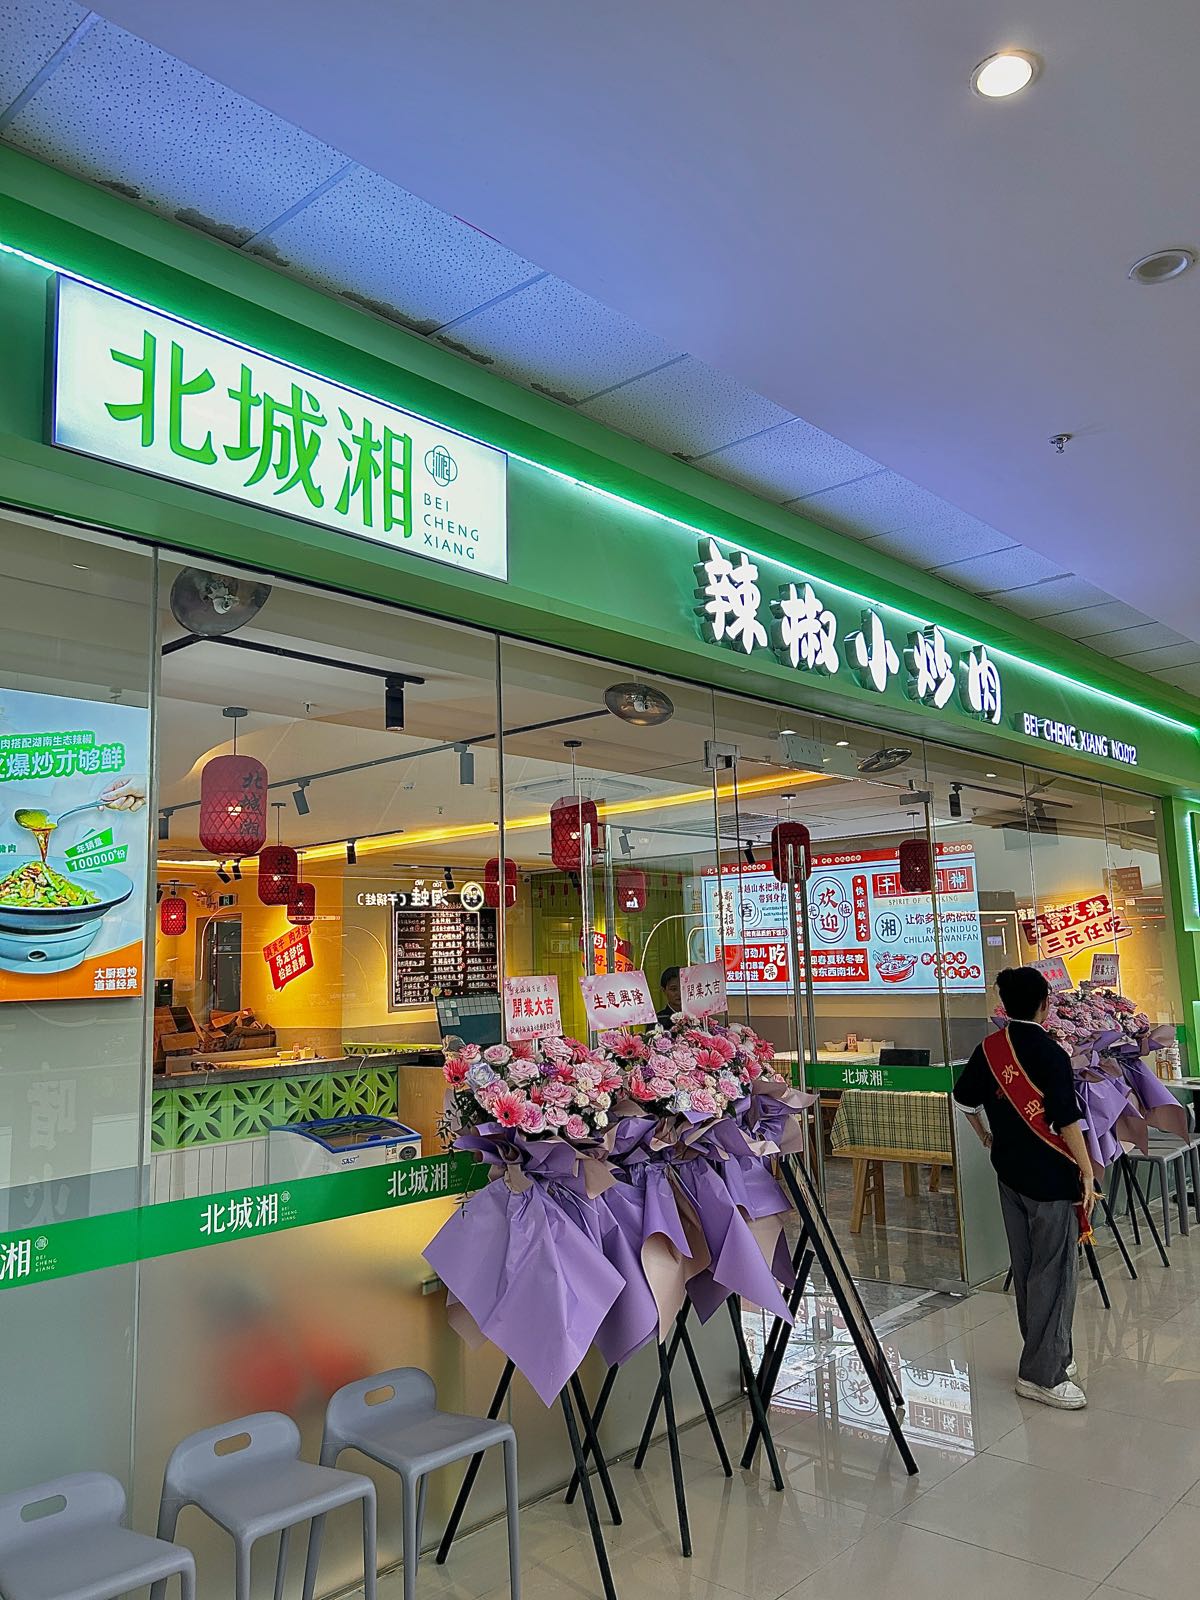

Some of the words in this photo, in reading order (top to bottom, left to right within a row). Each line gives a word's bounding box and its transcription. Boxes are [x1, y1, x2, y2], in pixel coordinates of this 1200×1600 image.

[104, 329, 412, 539] 北城湘
[423, 492, 449, 512] BEI
[423, 513, 479, 541] CHENG
[423, 532, 475, 559] XIANG
[700, 537, 1001, 725] 辣椒小炒肉
[1023, 712, 1039, 737] BEI
[1043, 719, 1076, 747] CHENG
[1079, 730, 1108, 756] XIANG
[817, 887, 840, 934] 欢迎
[888, 898, 909, 906] SPIRIT
[926, 894, 959, 904] CKING
[881, 919, 897, 937] 湘
[1047, 915, 1126, 954] 三元任吃
[512, 996, 555, 1019] 開業大吉
[593, 987, 645, 1010] 生意興隆
[842, 1068, 883, 1087] 北城湘
[387, 1162, 448, 1198] 北城湘
[199, 1192, 278, 1236] 北城湘
[0, 1239, 31, 1280] 湘
[35, 1257, 58, 1267] CHENG
